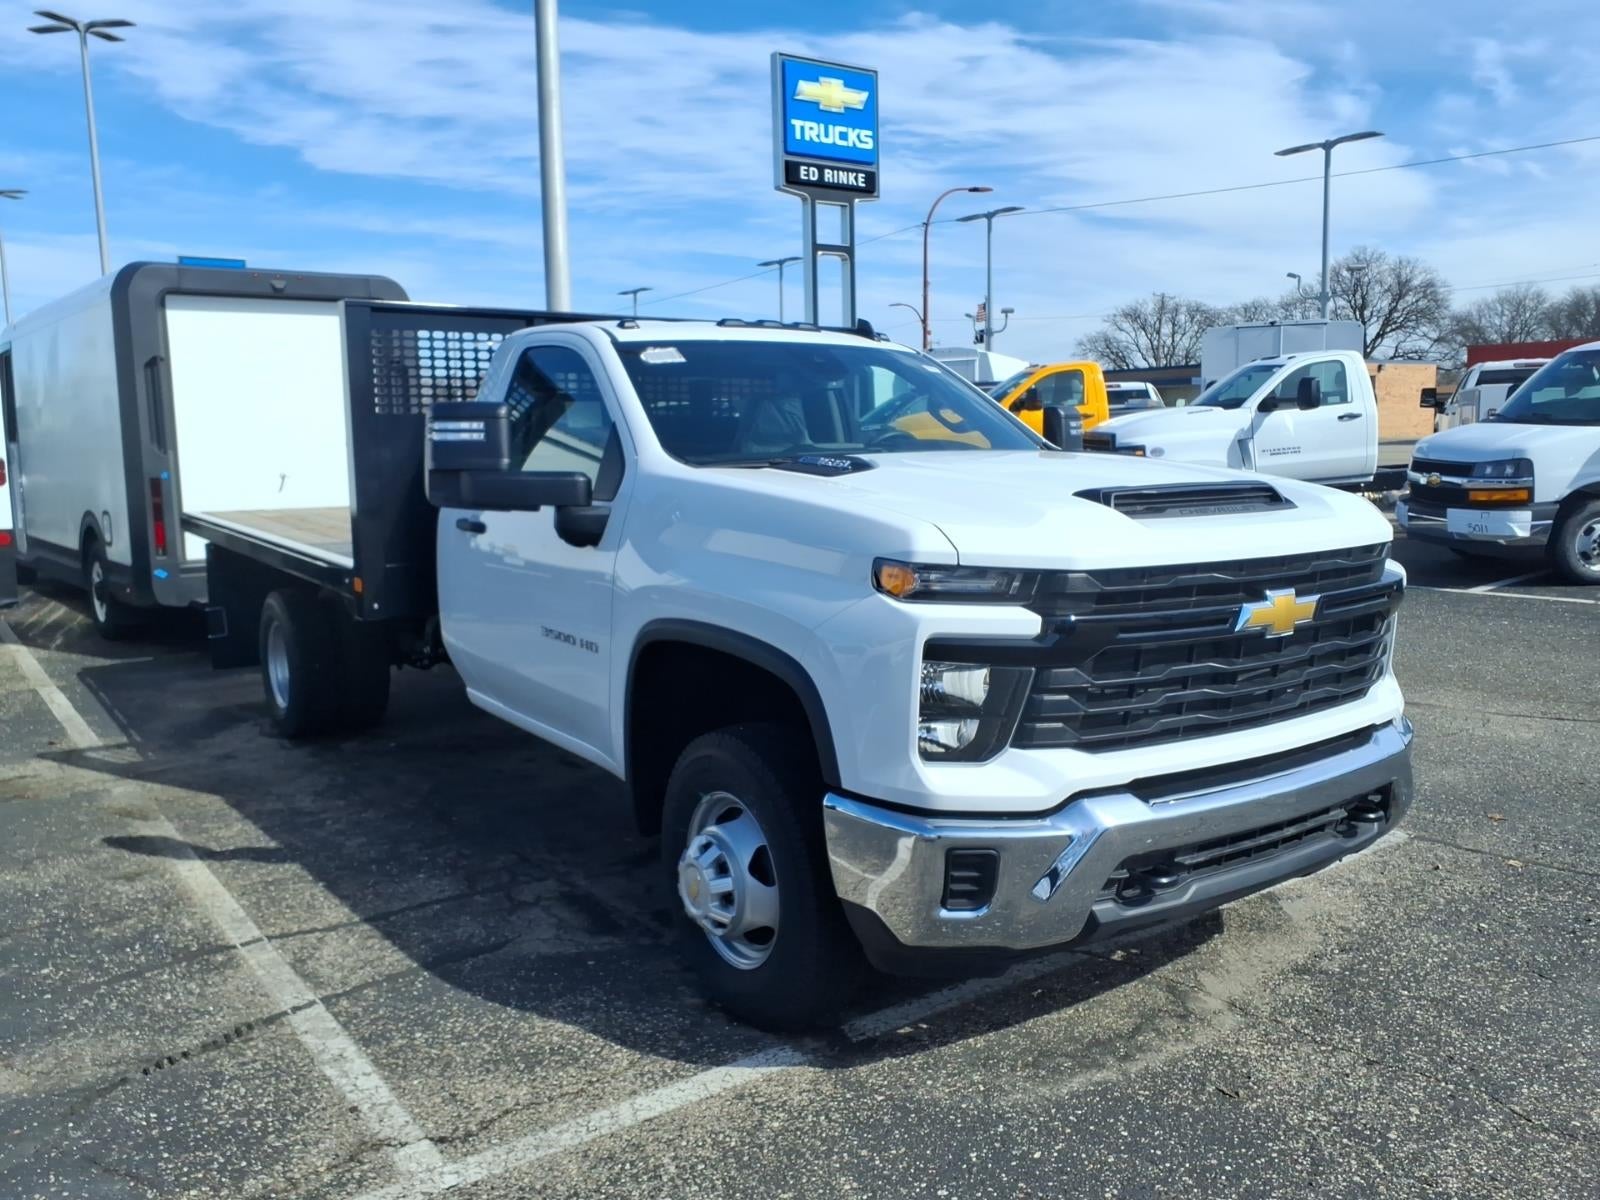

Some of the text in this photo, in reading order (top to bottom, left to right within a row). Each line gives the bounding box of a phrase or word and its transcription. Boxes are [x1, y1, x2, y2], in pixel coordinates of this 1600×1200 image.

[791, 118, 873, 150] TRUCKS
[800, 166, 866, 187] ED RINKE
